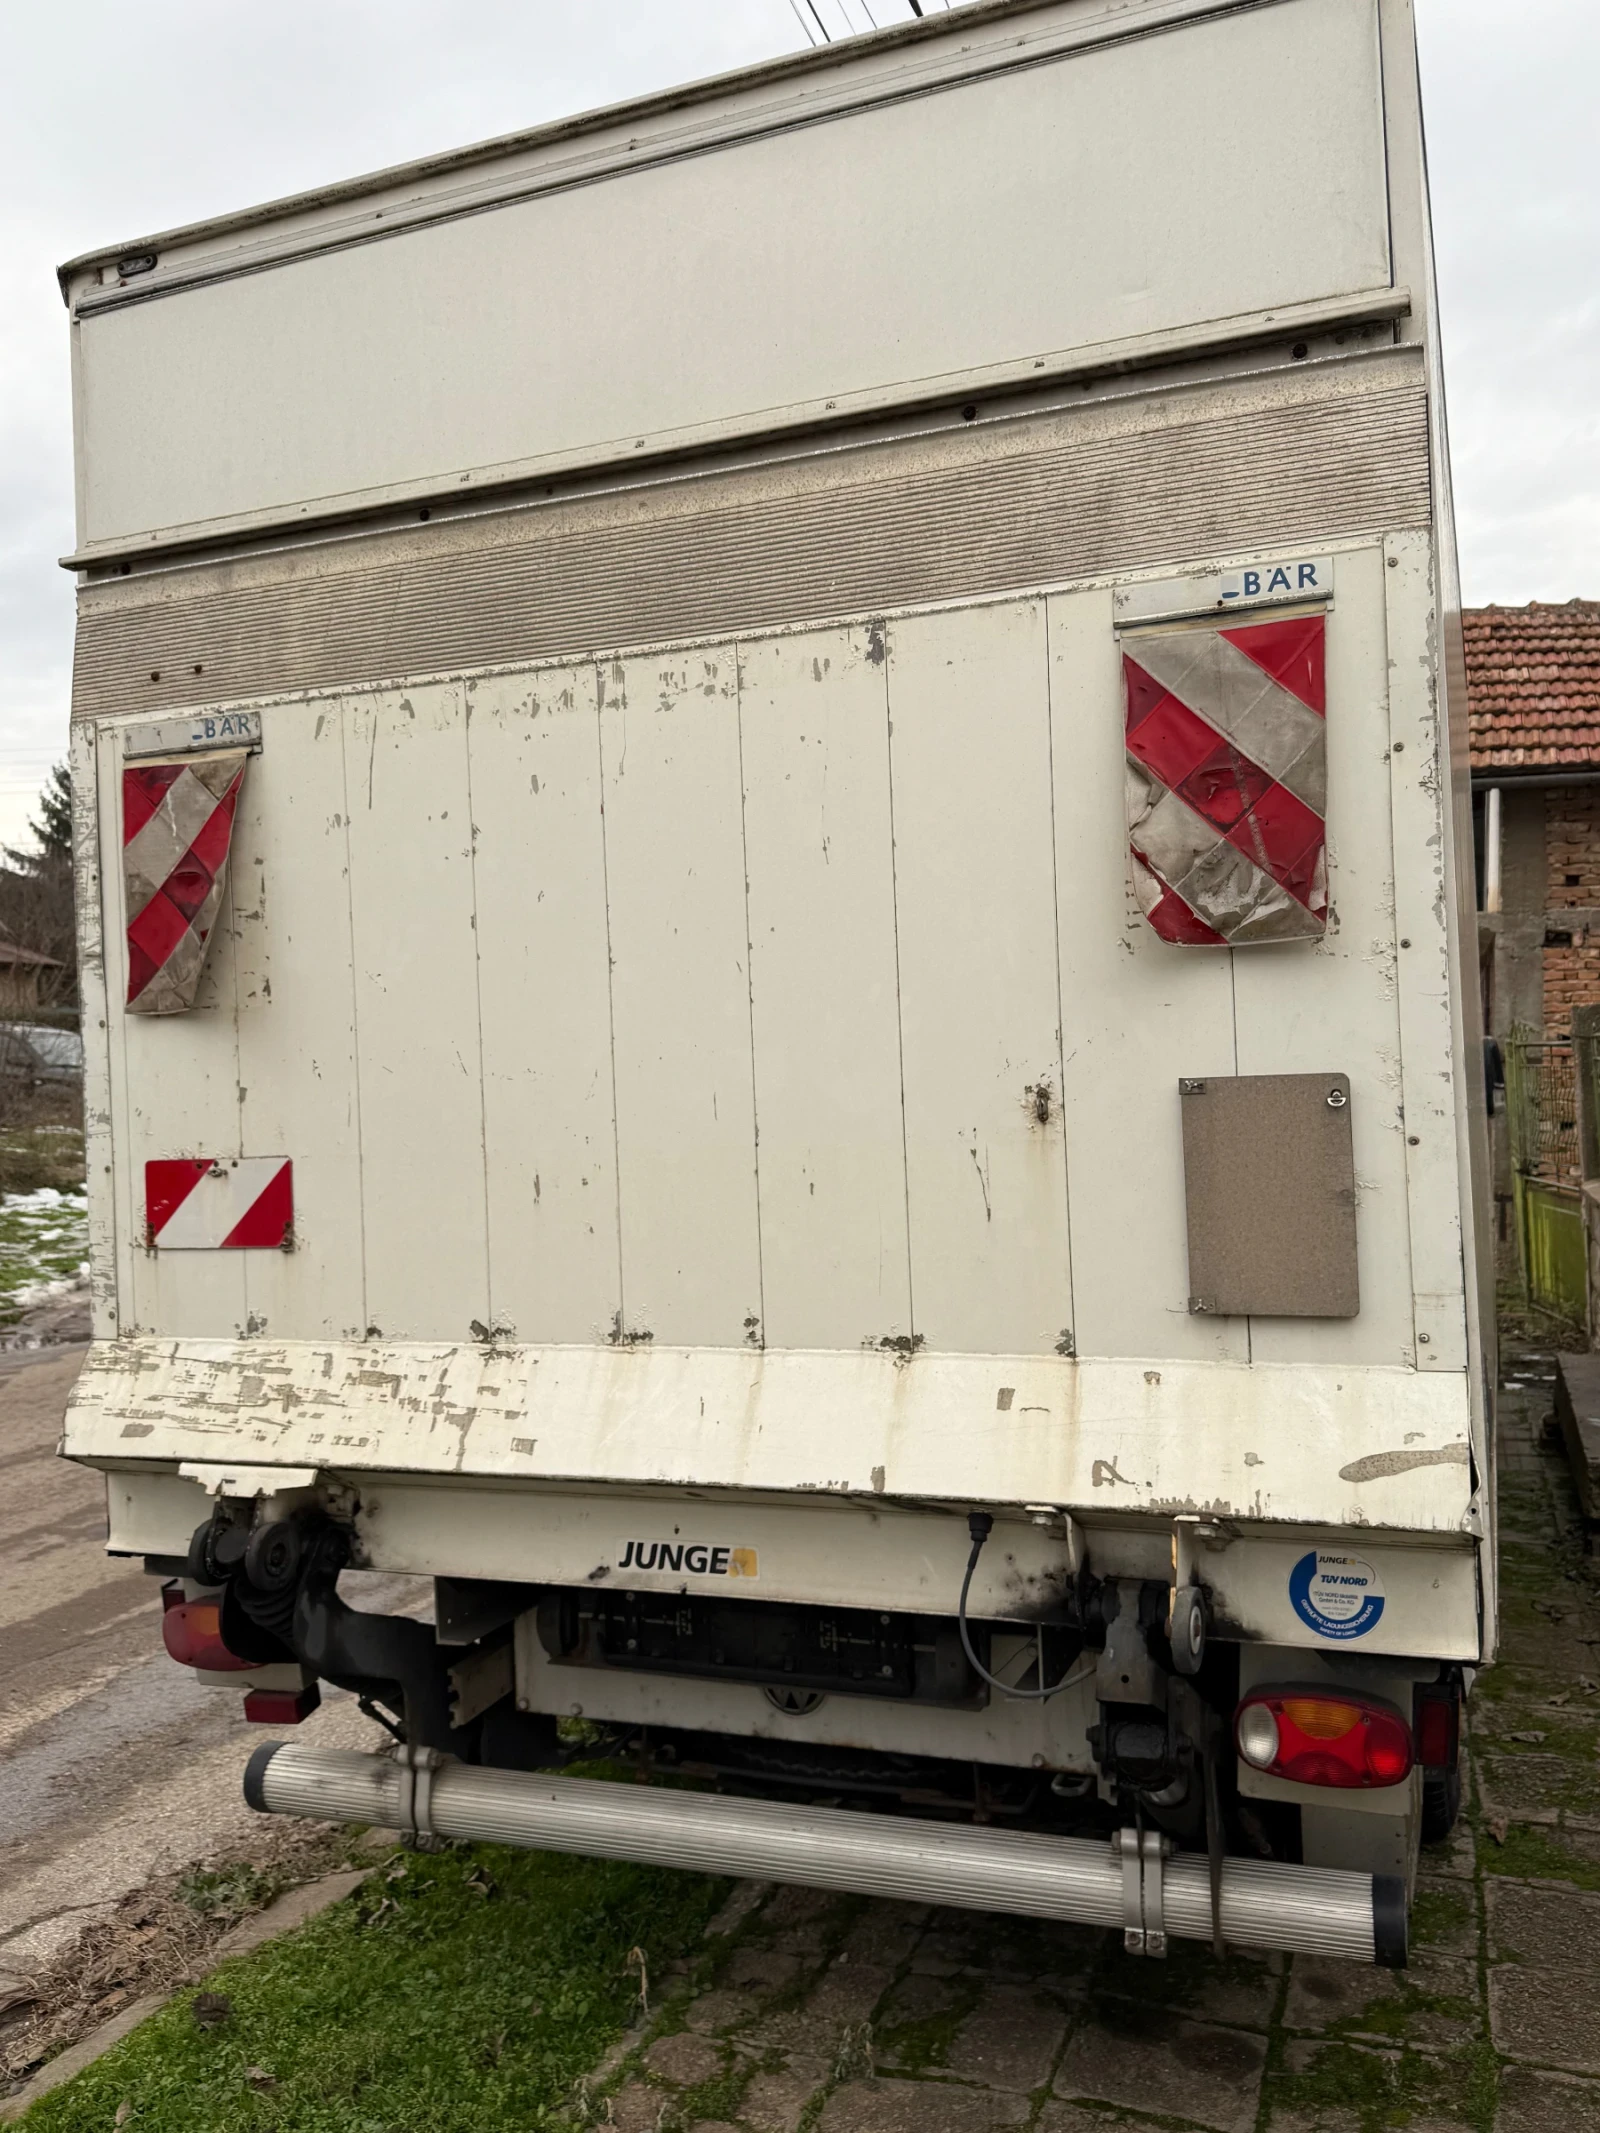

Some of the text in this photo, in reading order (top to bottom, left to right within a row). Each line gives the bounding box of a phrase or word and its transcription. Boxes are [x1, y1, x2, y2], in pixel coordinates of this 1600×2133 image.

[1243, 563, 1318, 596] BÄR
[618, 1541, 730, 1574] JUNGE
[1318, 1556, 1348, 1565] JUNGE
[1321, 1574, 1368, 1586] TÜV NORD
